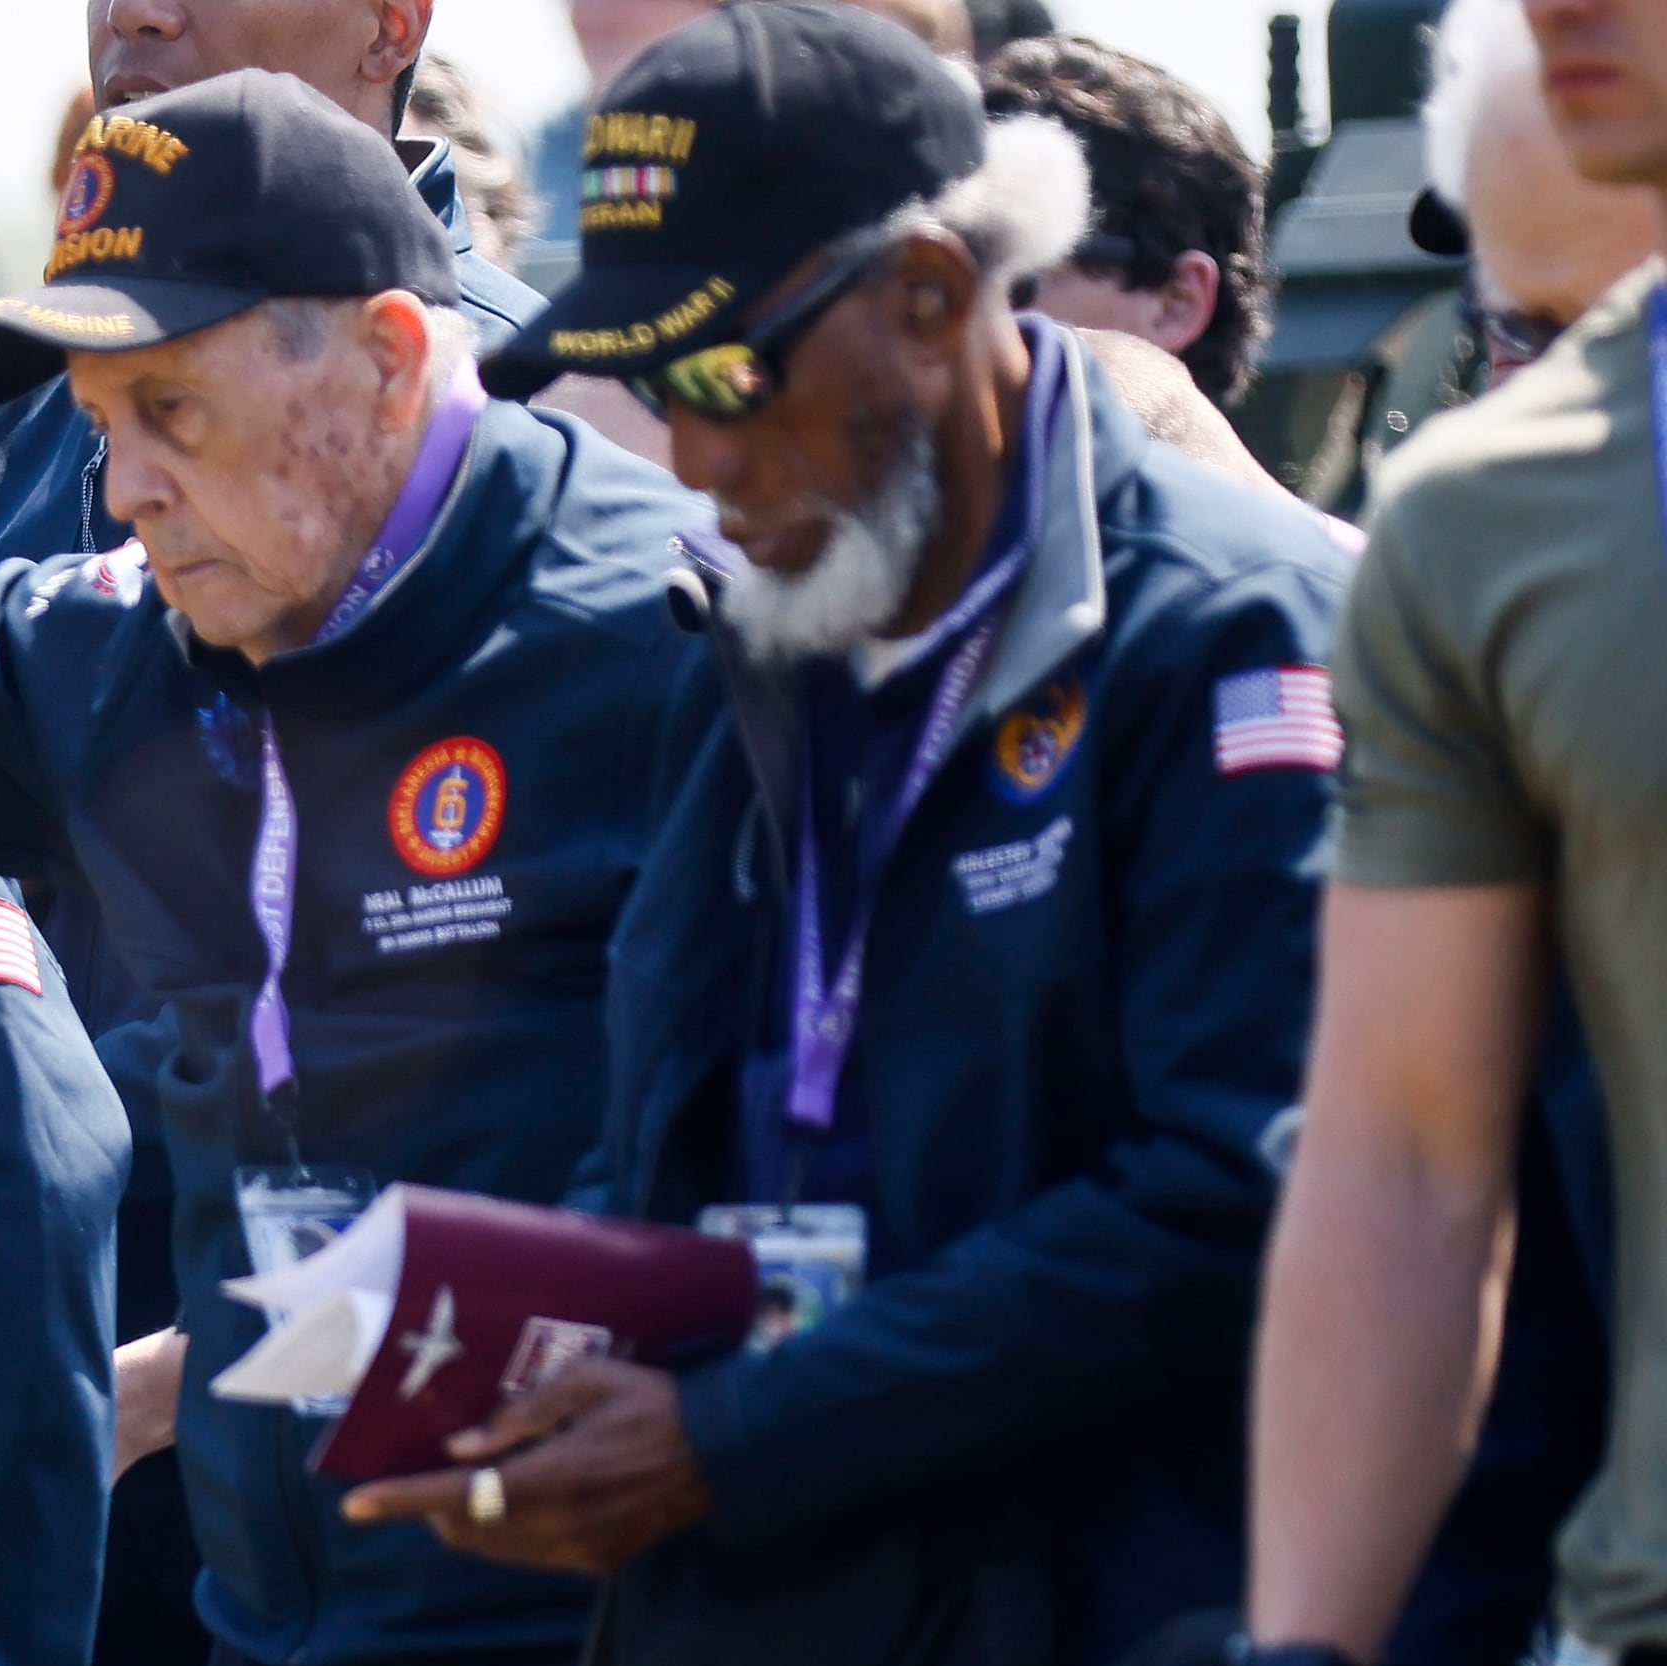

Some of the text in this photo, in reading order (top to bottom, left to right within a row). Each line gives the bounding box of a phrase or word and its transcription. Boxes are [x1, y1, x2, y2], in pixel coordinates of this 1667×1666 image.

[75, 115, 190, 176] ARINE
[582, 200, 663, 234] ERAN
[550, 321, 657, 361] WORLD
[654, 289, 717, 340] WAR
[433, 776, 469, 831] 6
